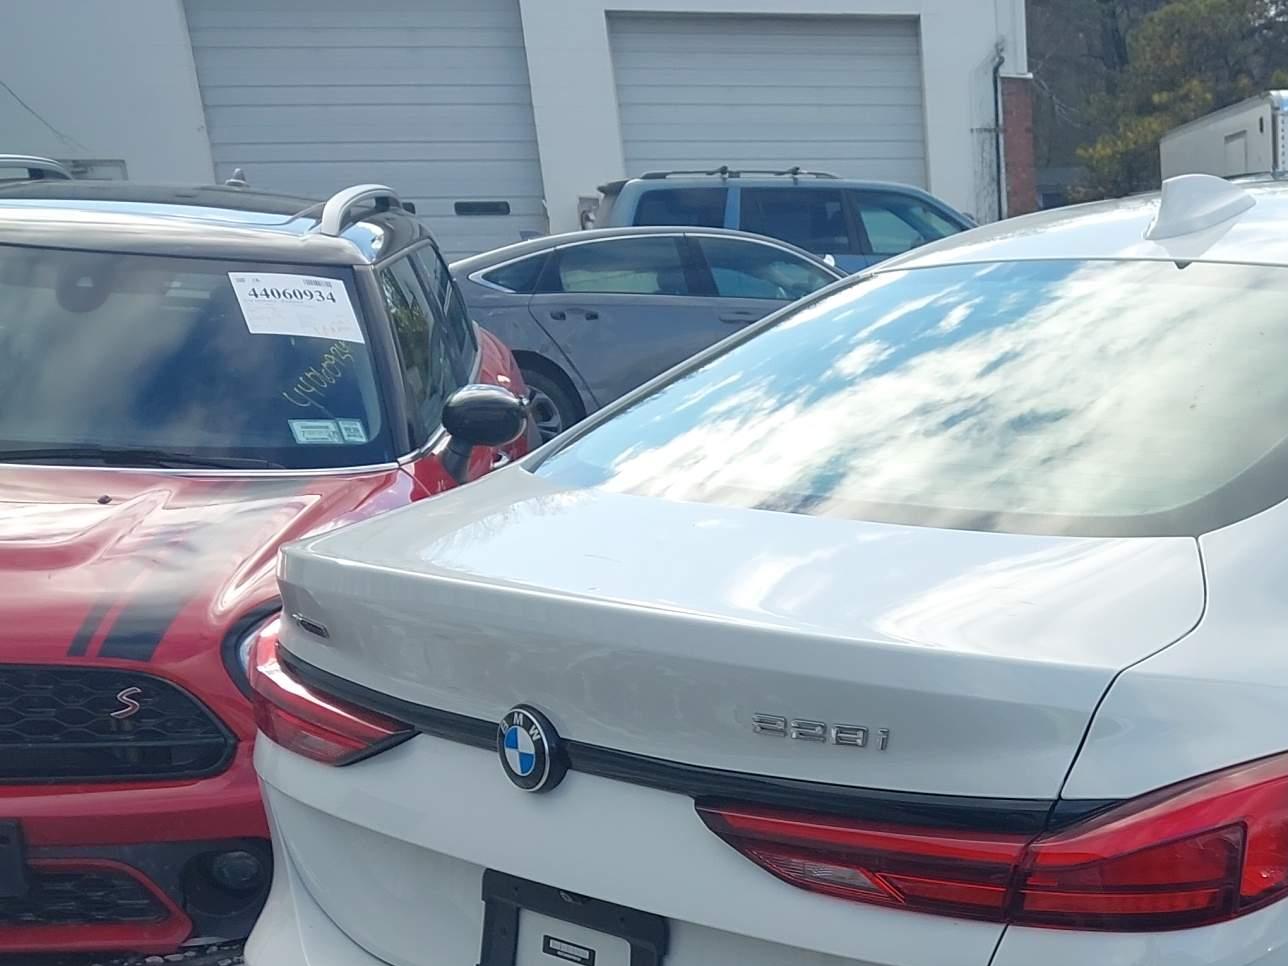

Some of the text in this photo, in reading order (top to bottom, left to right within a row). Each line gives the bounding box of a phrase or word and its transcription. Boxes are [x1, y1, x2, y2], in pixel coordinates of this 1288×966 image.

[248, 287, 336, 303] 44060934
[110, 686, 142, 719] S
[500, 712, 541, 741] BMW
[752, 713, 889, 751] 228i
